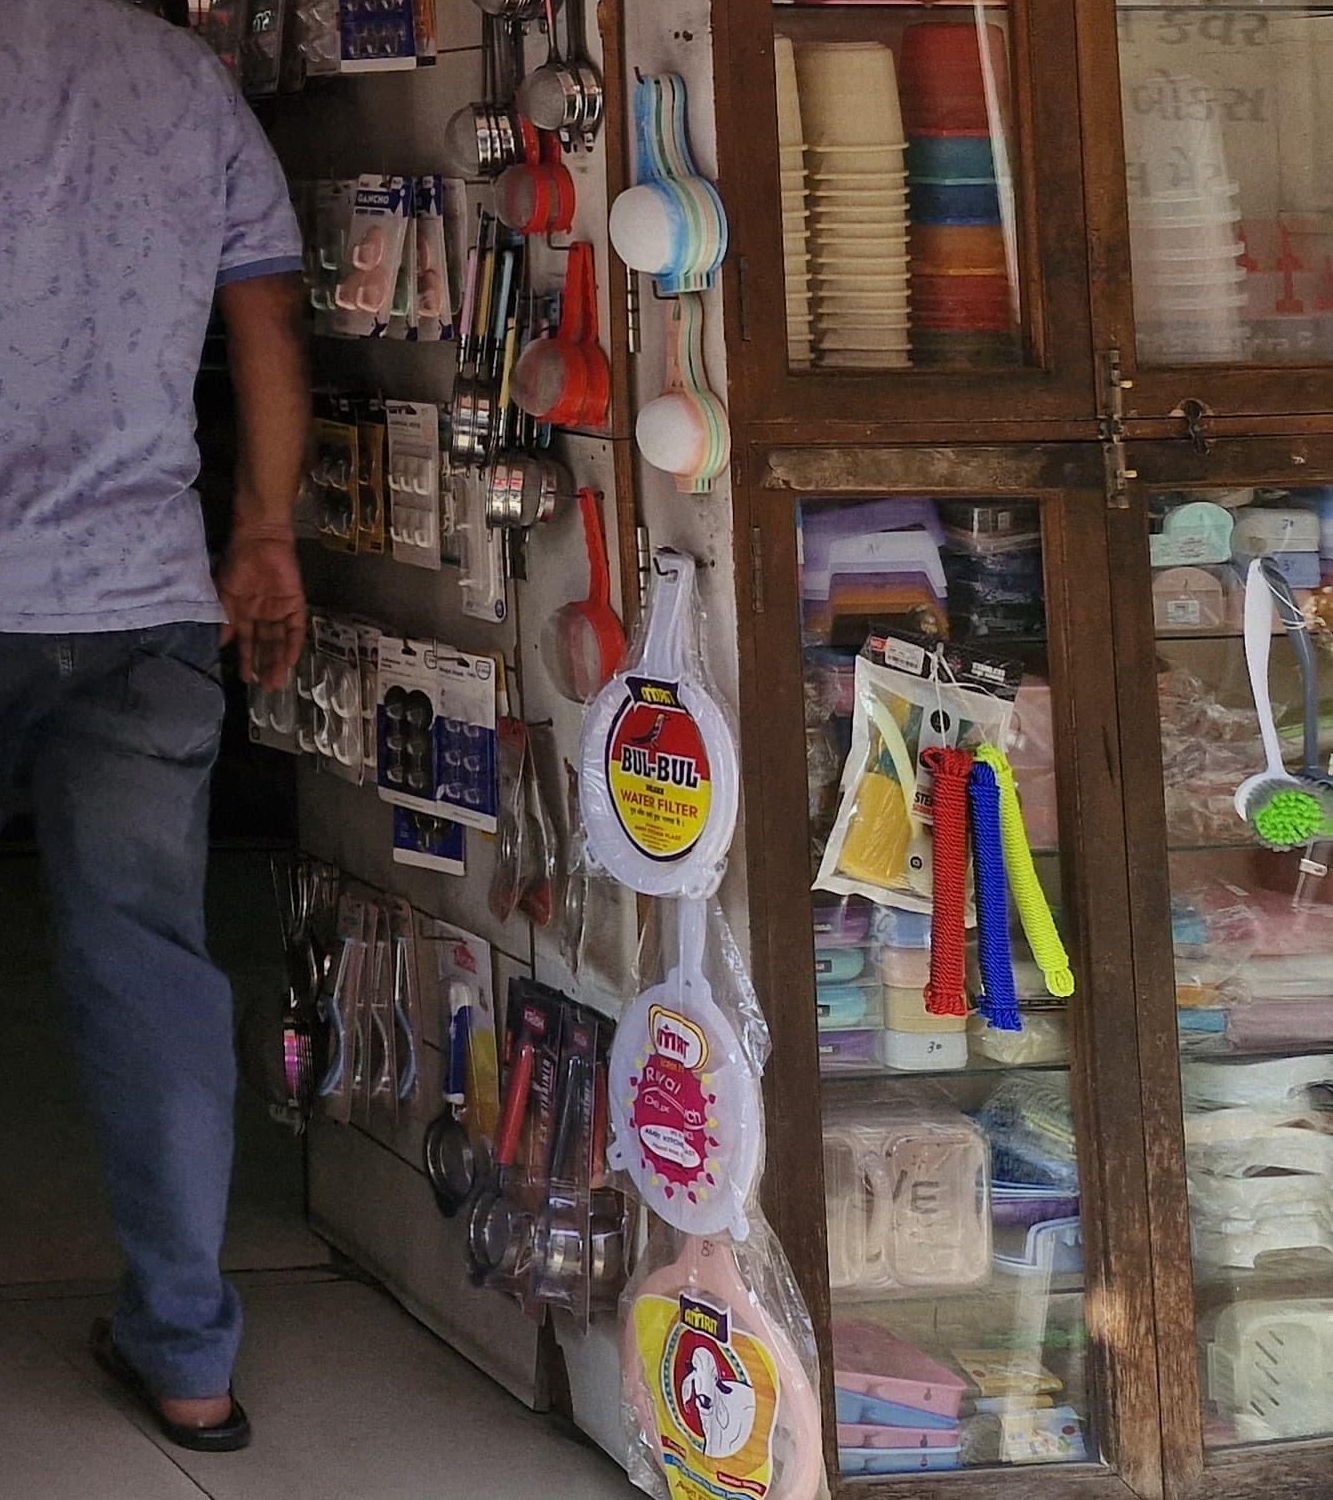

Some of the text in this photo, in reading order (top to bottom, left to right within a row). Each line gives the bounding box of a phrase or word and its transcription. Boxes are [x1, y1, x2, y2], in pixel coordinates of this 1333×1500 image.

[621, 745, 699, 789] BUL-BUL
[620, 788, 655, 809] WATER
[658, 799, 698, 819] FILTER
